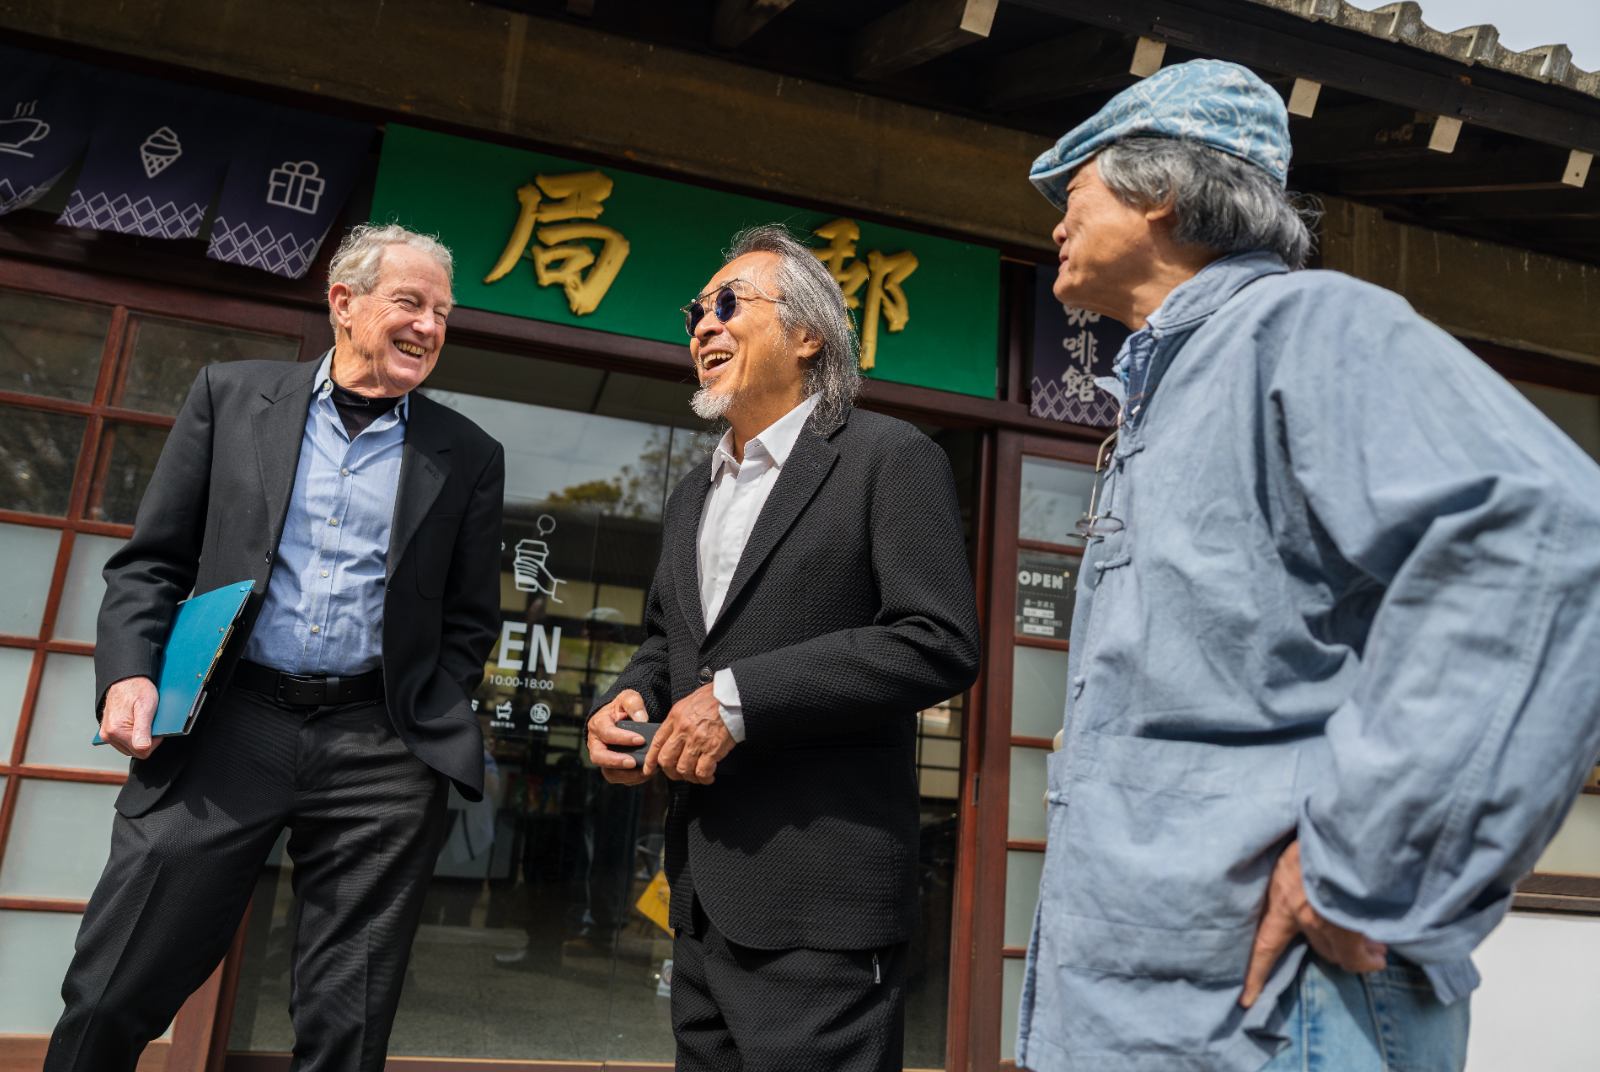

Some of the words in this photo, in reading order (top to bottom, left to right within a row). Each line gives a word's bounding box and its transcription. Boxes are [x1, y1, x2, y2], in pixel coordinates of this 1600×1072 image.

[1018, 570, 1064, 590] OPEN
[498, 621, 562, 675] EN
[489, 674, 554, 691] 10:00-18:00
